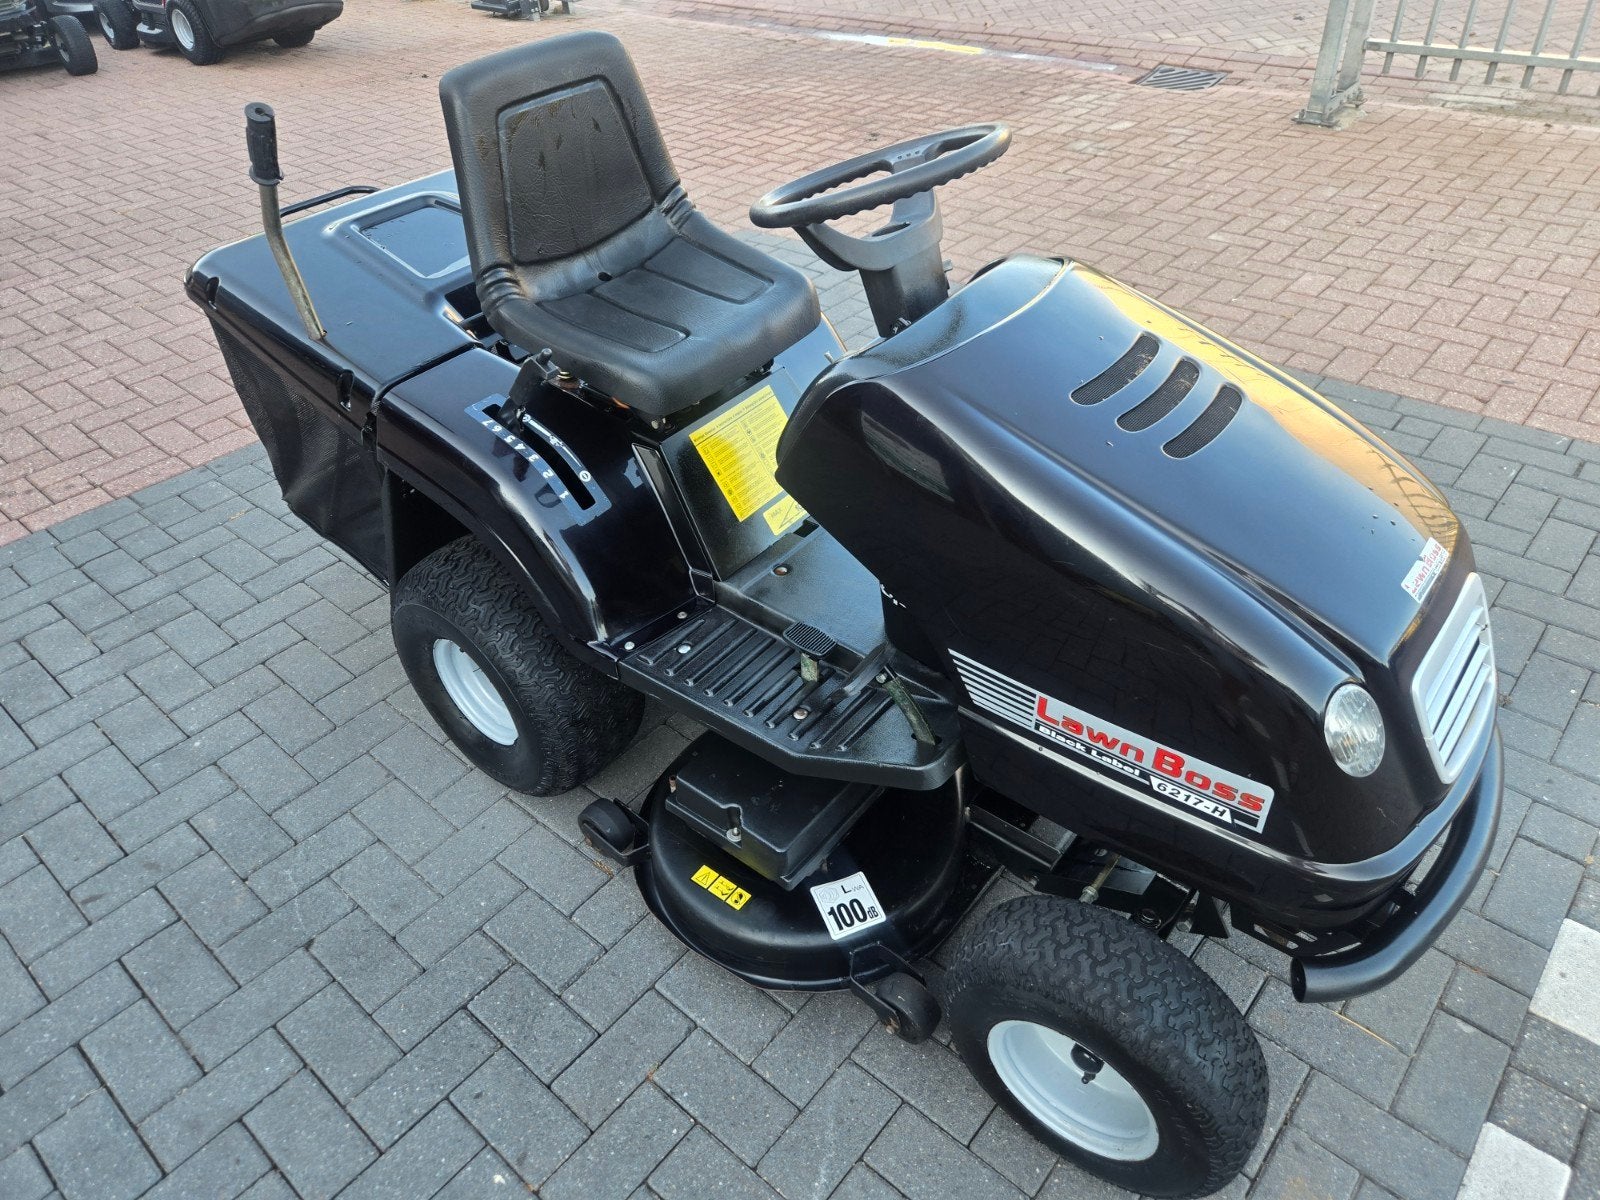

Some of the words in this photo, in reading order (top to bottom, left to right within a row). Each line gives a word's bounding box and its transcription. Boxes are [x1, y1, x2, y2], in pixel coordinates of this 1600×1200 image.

[504, 435, 515, 443] 5
[514, 443, 526, 451] 4
[528, 454, 539, 462] 3
[542, 469, 554, 478] 2
[559, 491, 569, 499] 1
[1036, 695, 1145, 763] Lawn
[1152, 747, 1266, 812] Boss
[1037, 724, 1087, 753] Black
[1090, 748, 1140, 777] Label
[1156, 781, 1228, 819] 6217-H
